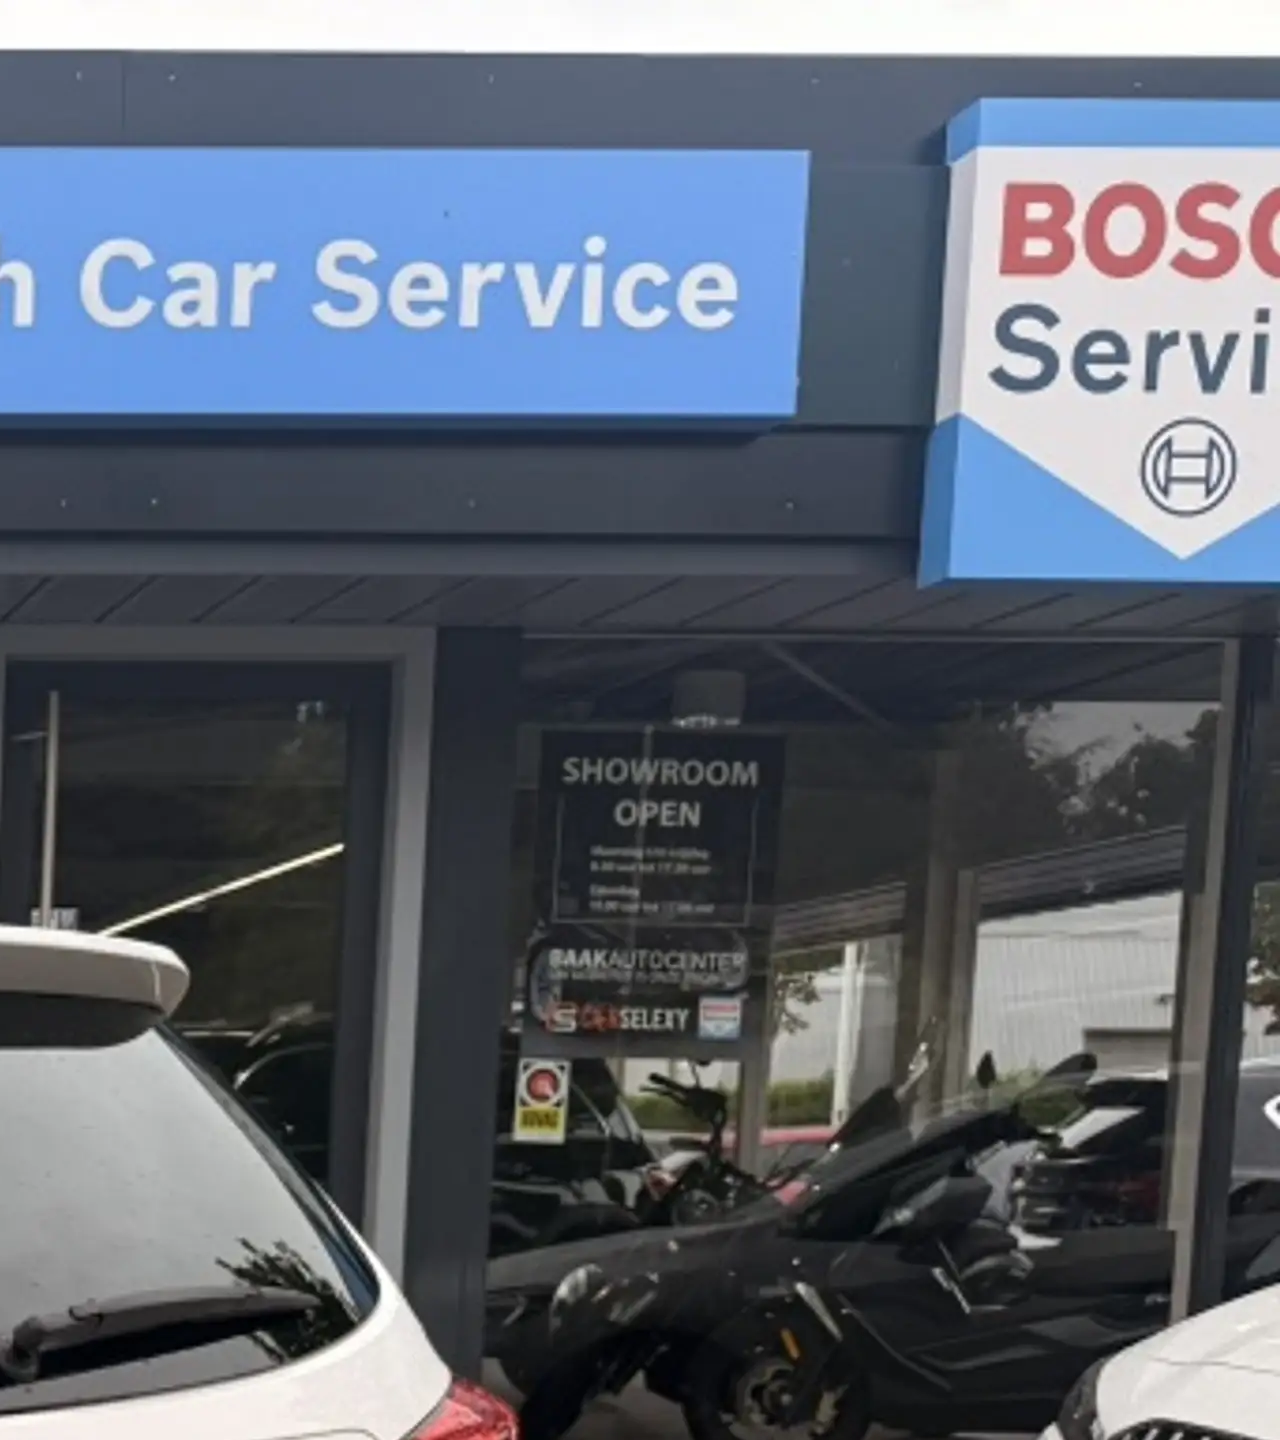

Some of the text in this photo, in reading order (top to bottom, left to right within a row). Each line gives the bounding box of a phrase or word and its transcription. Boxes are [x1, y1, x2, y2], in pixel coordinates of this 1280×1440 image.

[80, 238, 277, 328] Car
[311, 236, 738, 330] Service
[988, 302, 1271, 395] Servi
[562, 756, 759, 787] SHOWROOM
[614, 799, 701, 828] OPEN
